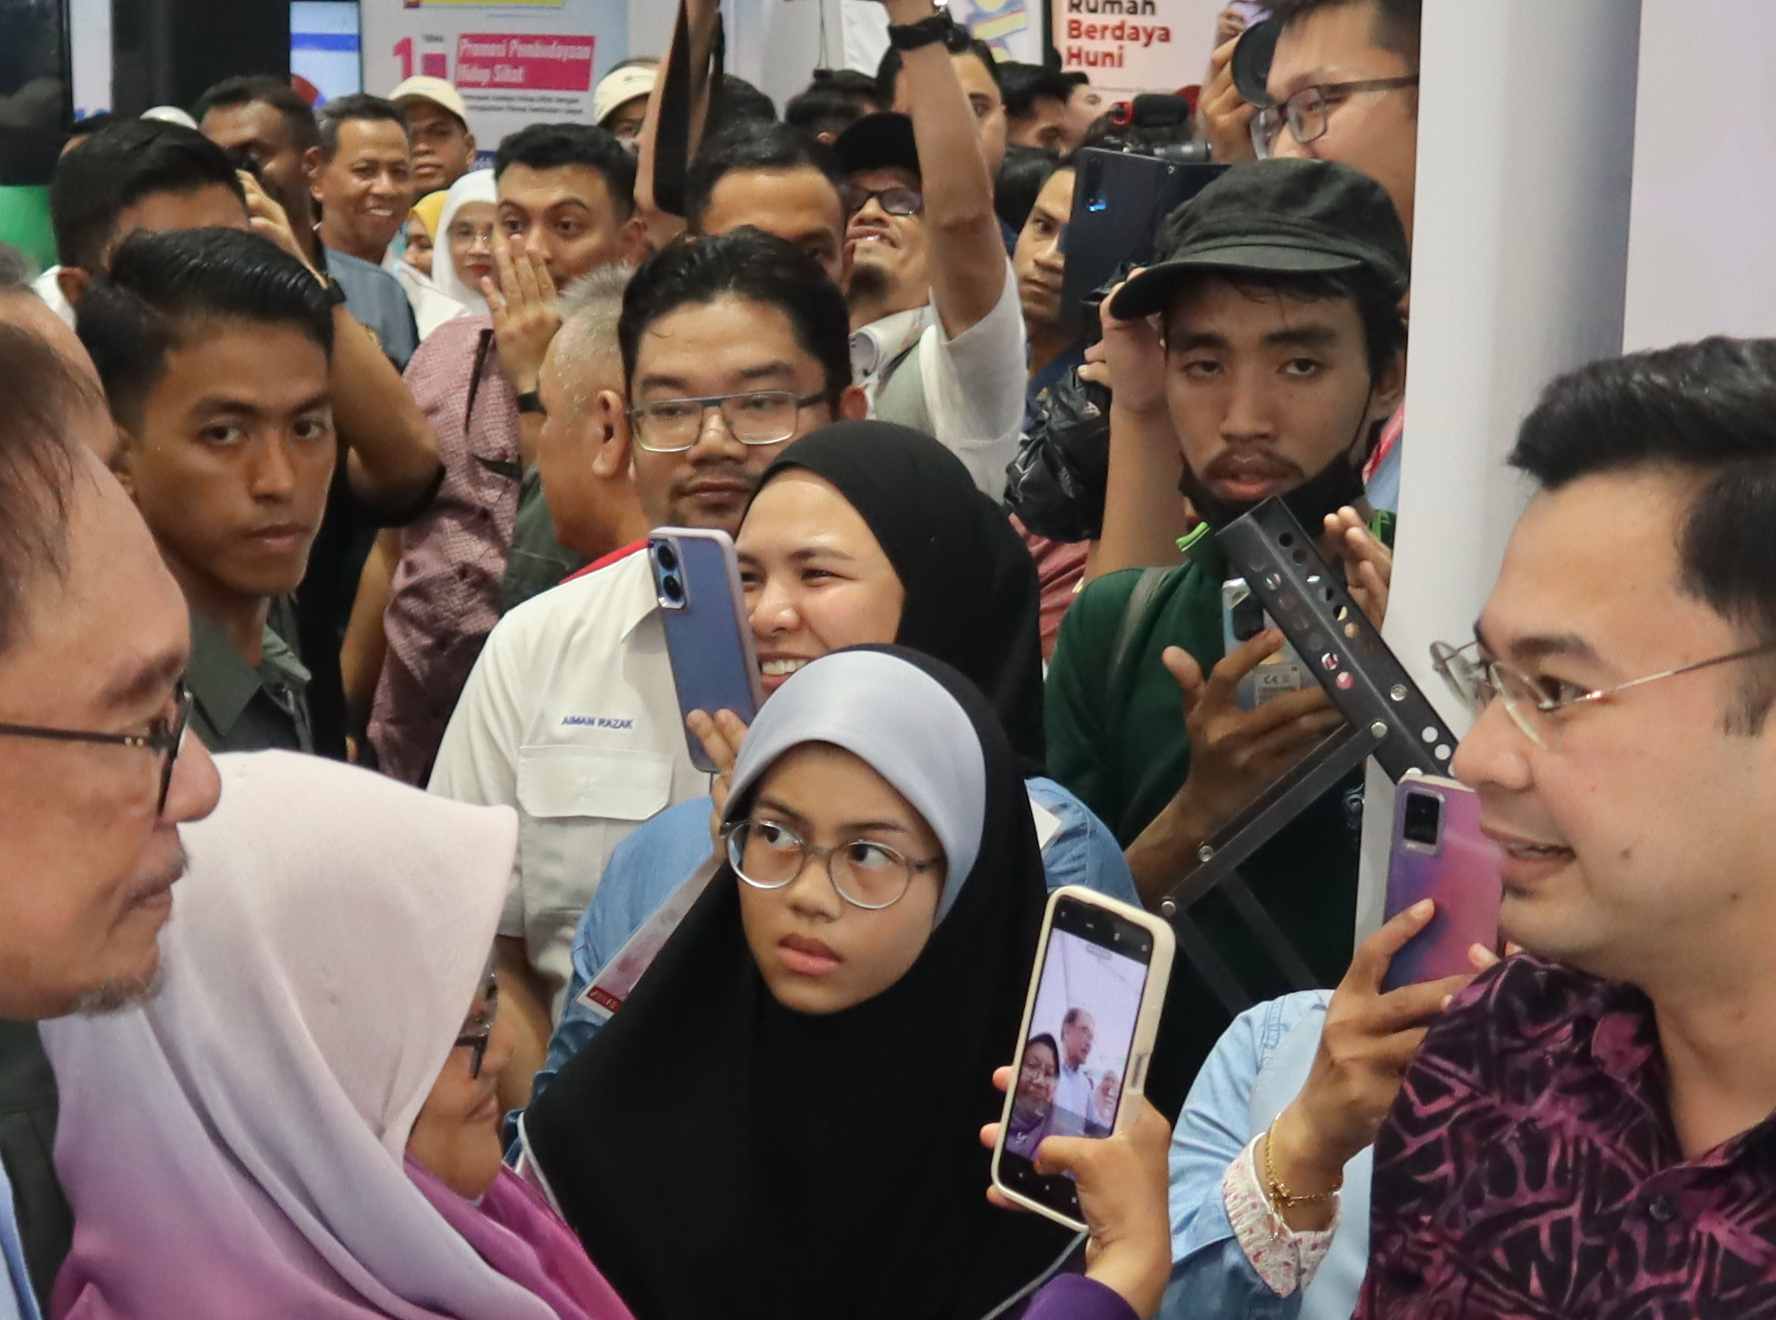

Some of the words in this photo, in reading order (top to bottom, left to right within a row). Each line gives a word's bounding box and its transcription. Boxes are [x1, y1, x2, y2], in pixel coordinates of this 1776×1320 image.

[1066, 19, 1171, 47] Berdaya
[1065, 47, 1124, 68] Huni
[562, 716, 596, 726] AIMAN
[597, 718, 634, 729] RAZAK
